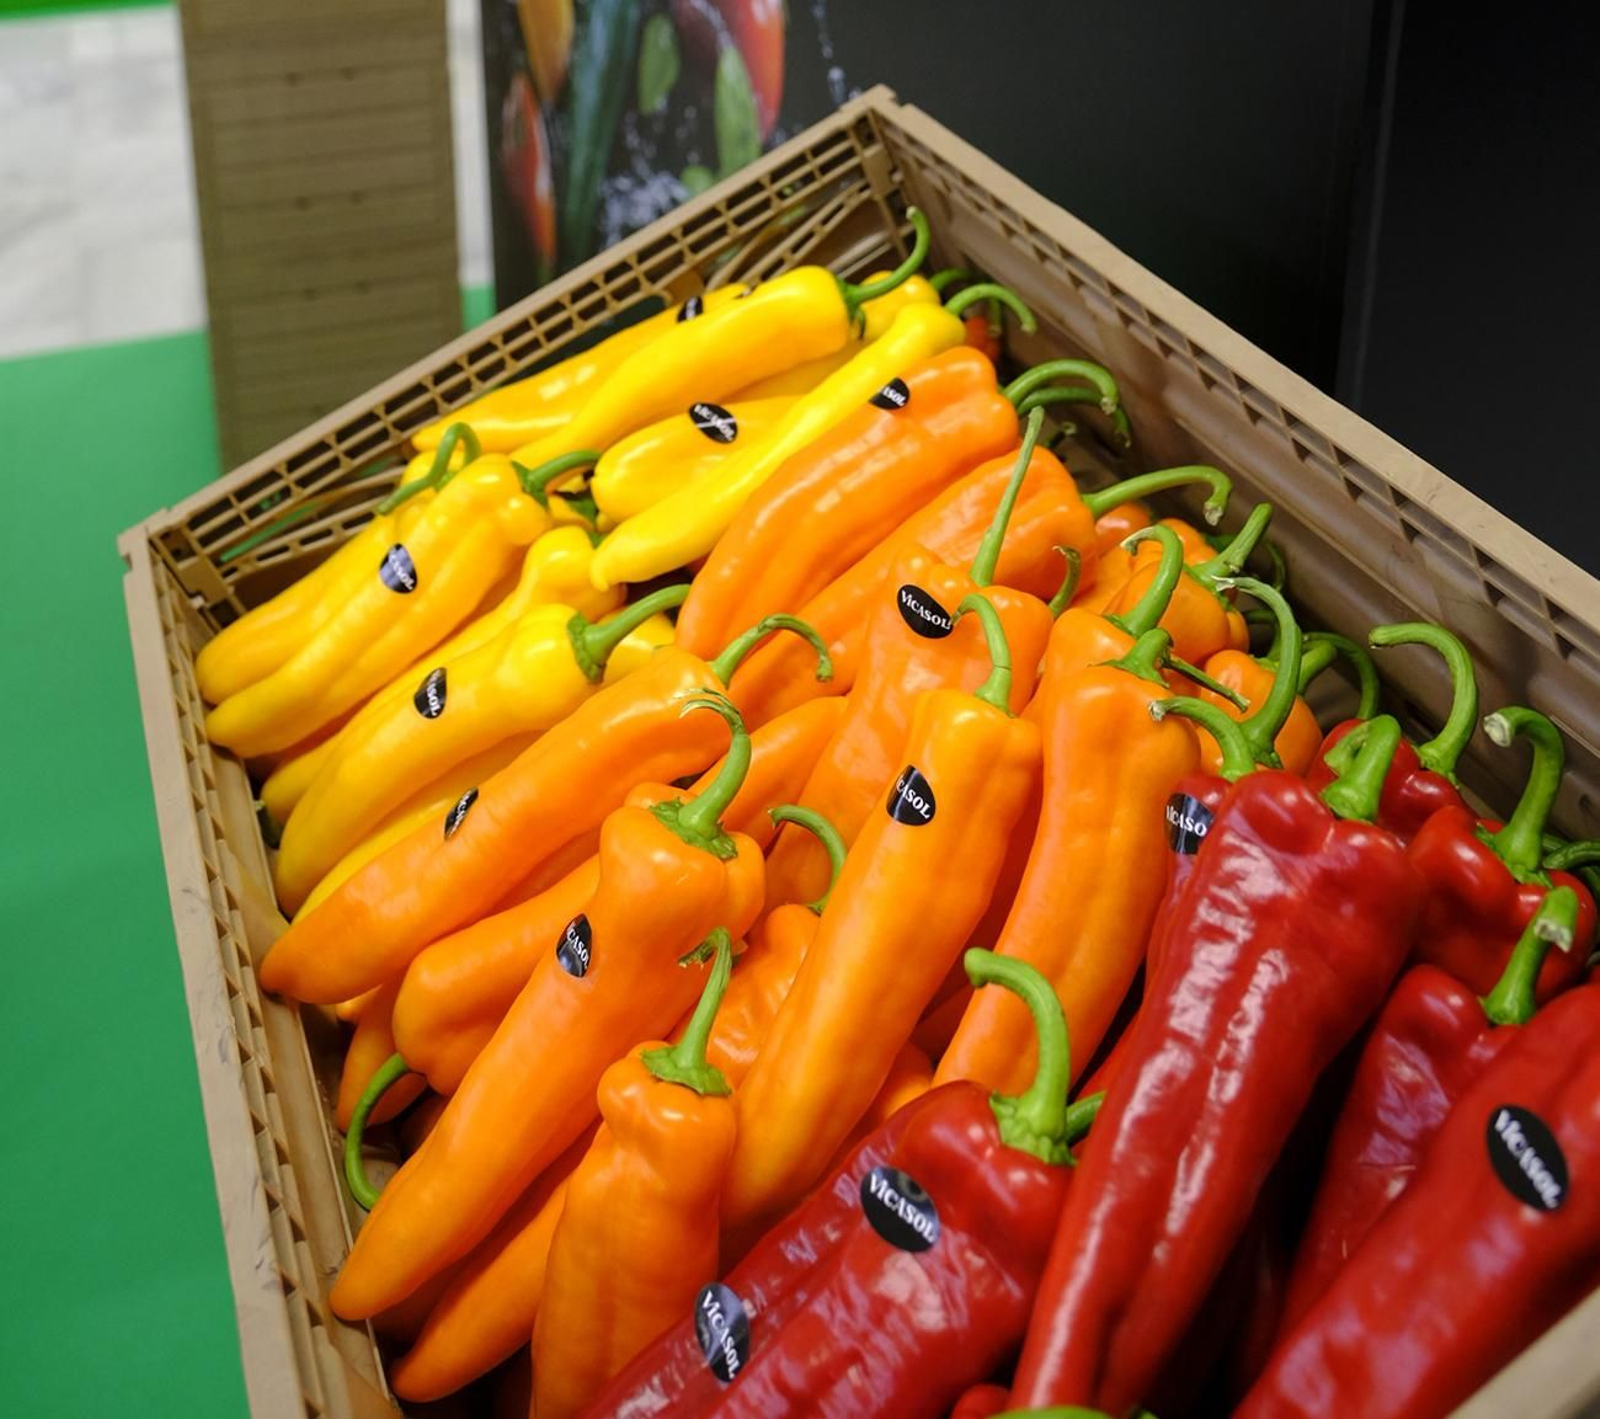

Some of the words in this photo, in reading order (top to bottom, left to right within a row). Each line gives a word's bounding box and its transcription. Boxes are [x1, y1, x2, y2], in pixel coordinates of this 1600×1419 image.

[900, 588, 953, 631] VICASOL
[1494, 1108, 1563, 1210] VICASOL
[869, 1171, 935, 1244] VICASOL
[702, 1289, 741, 1380] VICASOL
